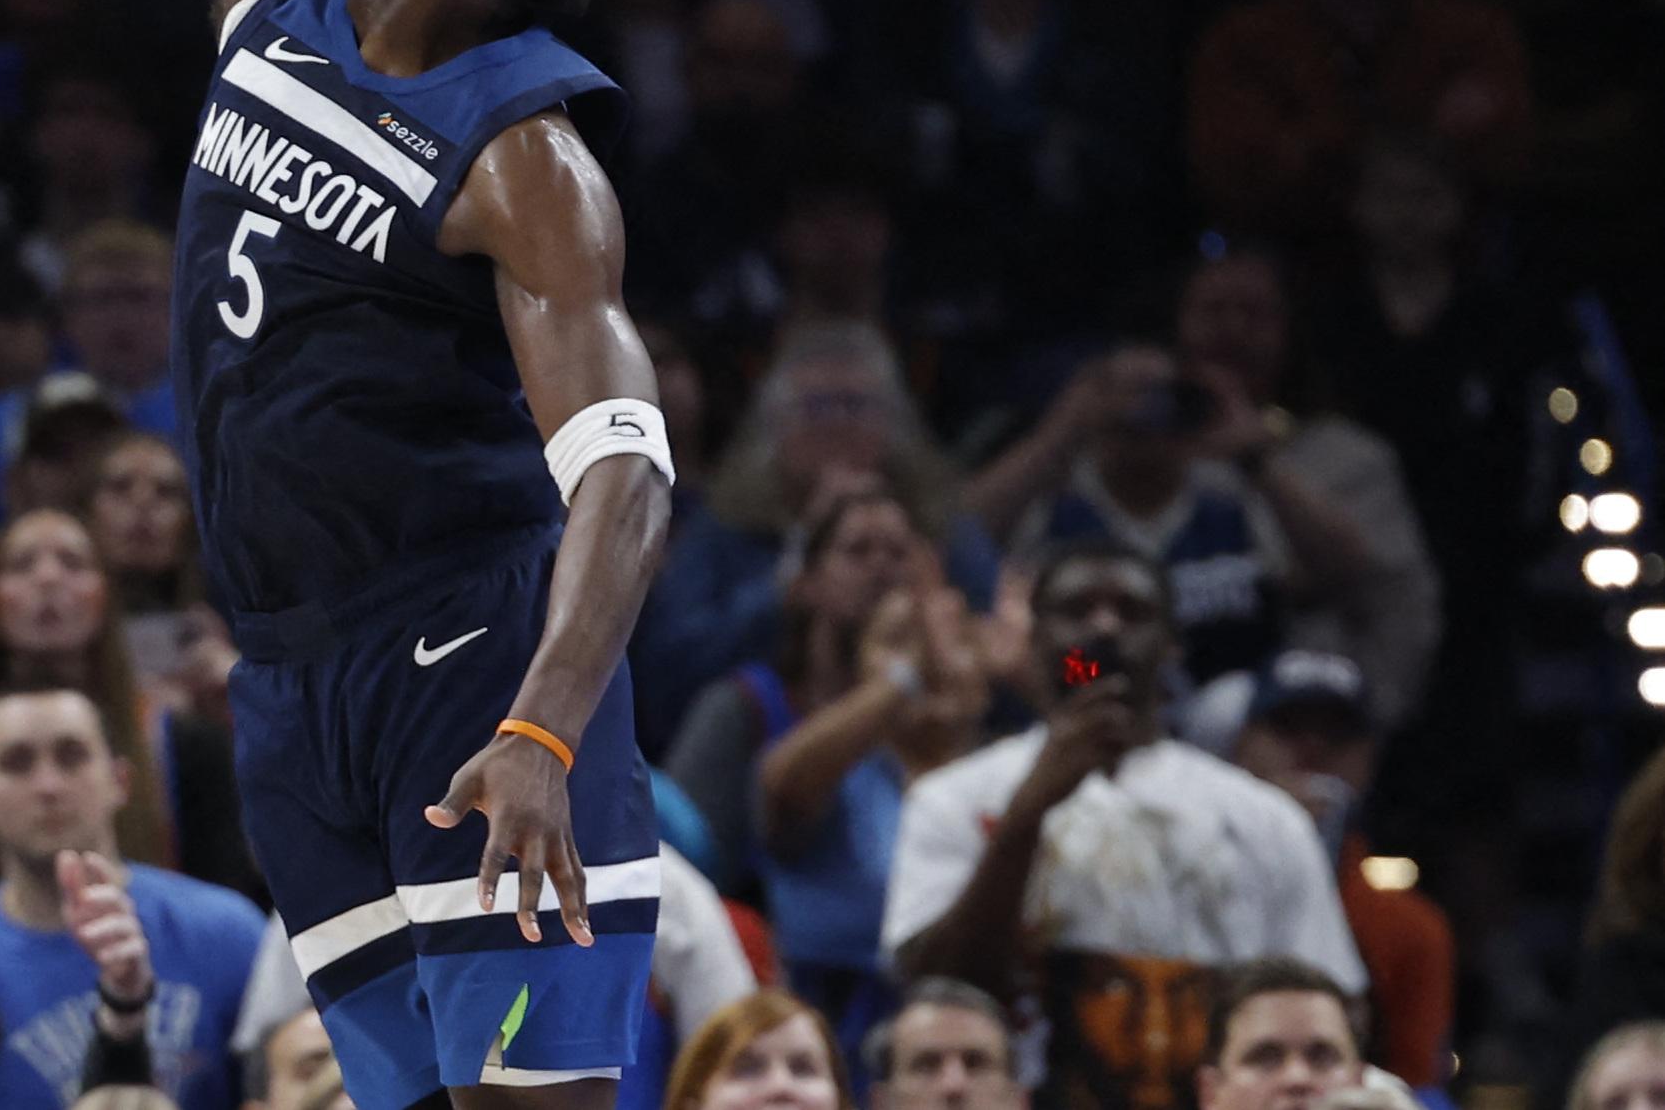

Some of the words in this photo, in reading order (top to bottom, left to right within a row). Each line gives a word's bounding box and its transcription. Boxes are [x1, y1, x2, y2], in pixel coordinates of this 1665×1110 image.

[386, 120, 439, 160] sezzle
[192, 102, 397, 264] MINNESOTA
[217, 209, 283, 339] 5
[609, 412, 646, 438] 5
